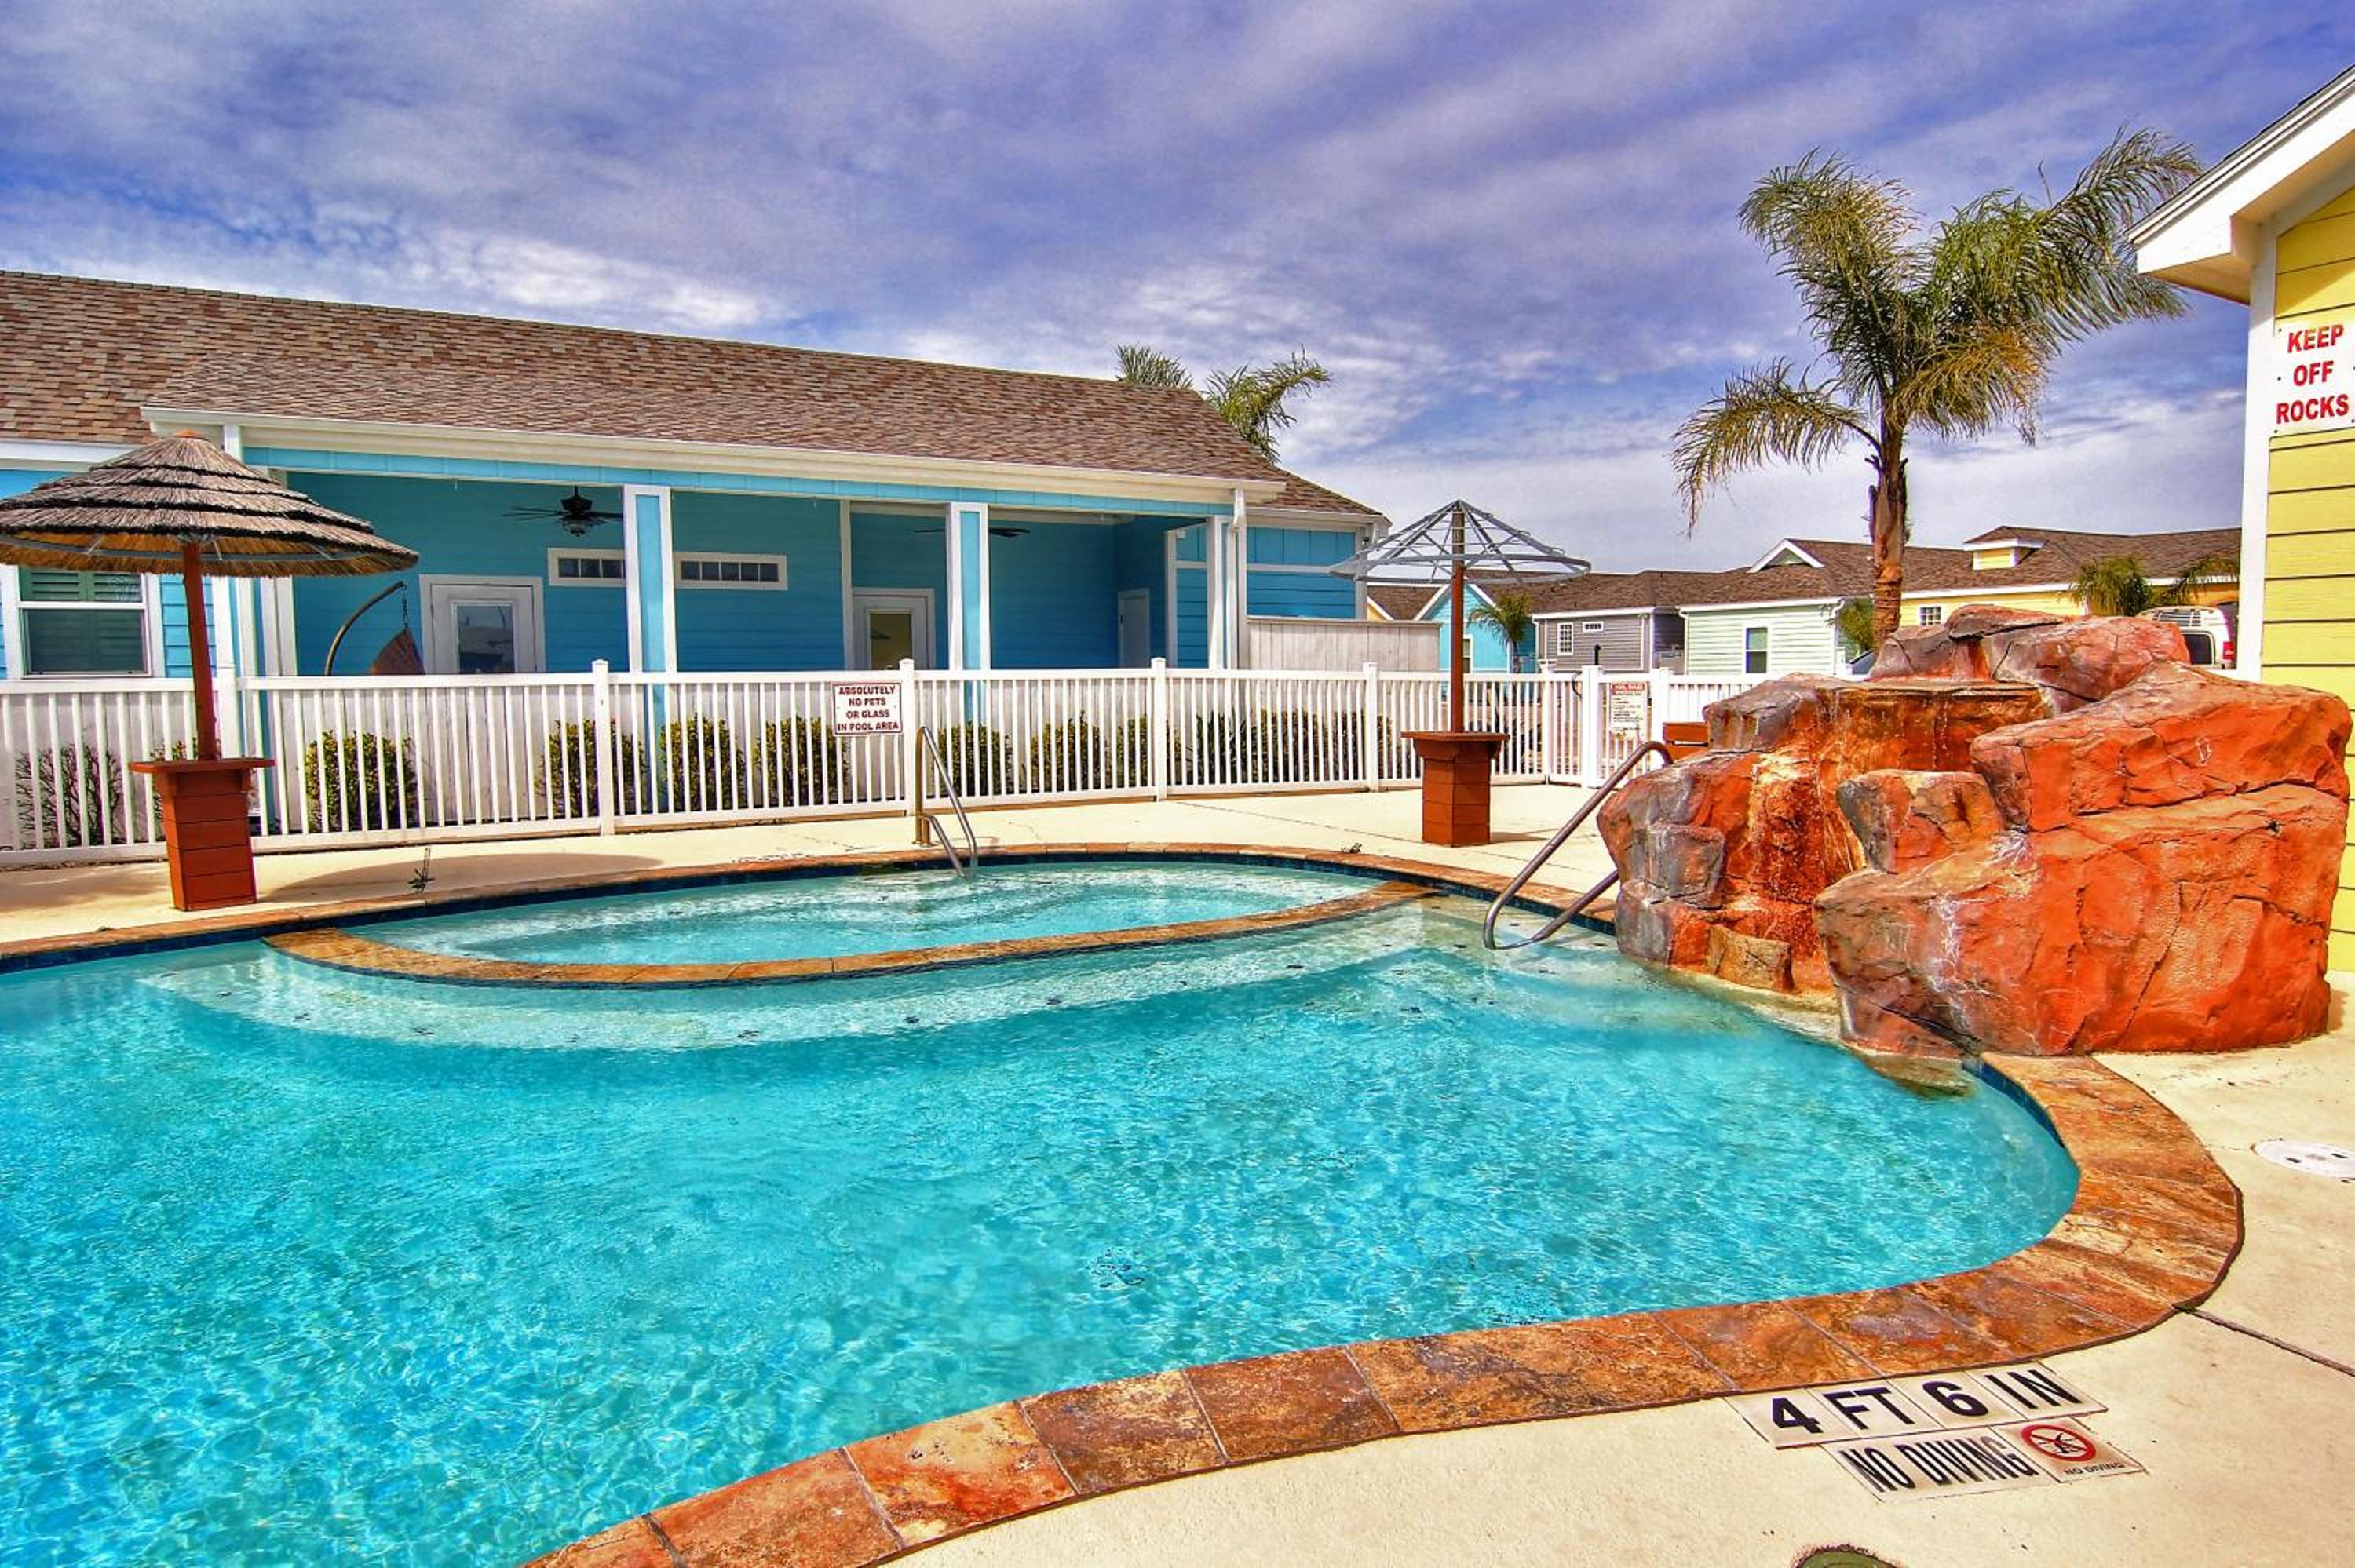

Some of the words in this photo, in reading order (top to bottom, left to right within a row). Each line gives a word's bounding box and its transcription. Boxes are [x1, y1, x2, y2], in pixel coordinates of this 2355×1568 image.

[2287, 324, 2344, 353] KEEP
[2293, 360, 2334, 386] OFF
[2276, 394, 2350, 425] ROCKS
[839, 686, 896, 695] ABSOLUTELY
[864, 698, 886, 706] PETS
[846, 710, 859, 719] OR
[861, 709, 890, 718] GLASS
[849, 723, 873, 731] POOL
[875, 721, 899, 730] AREA
[1772, 1397, 1823, 1434] 4
[1824, 1387, 1915, 1430] FT
[1922, 1380, 1989, 1417] 6
[1985, 1369, 2083, 1409] IN
[1838, 1447, 1915, 1492] NO
[1893, 1435, 2039, 1486] DIVING
